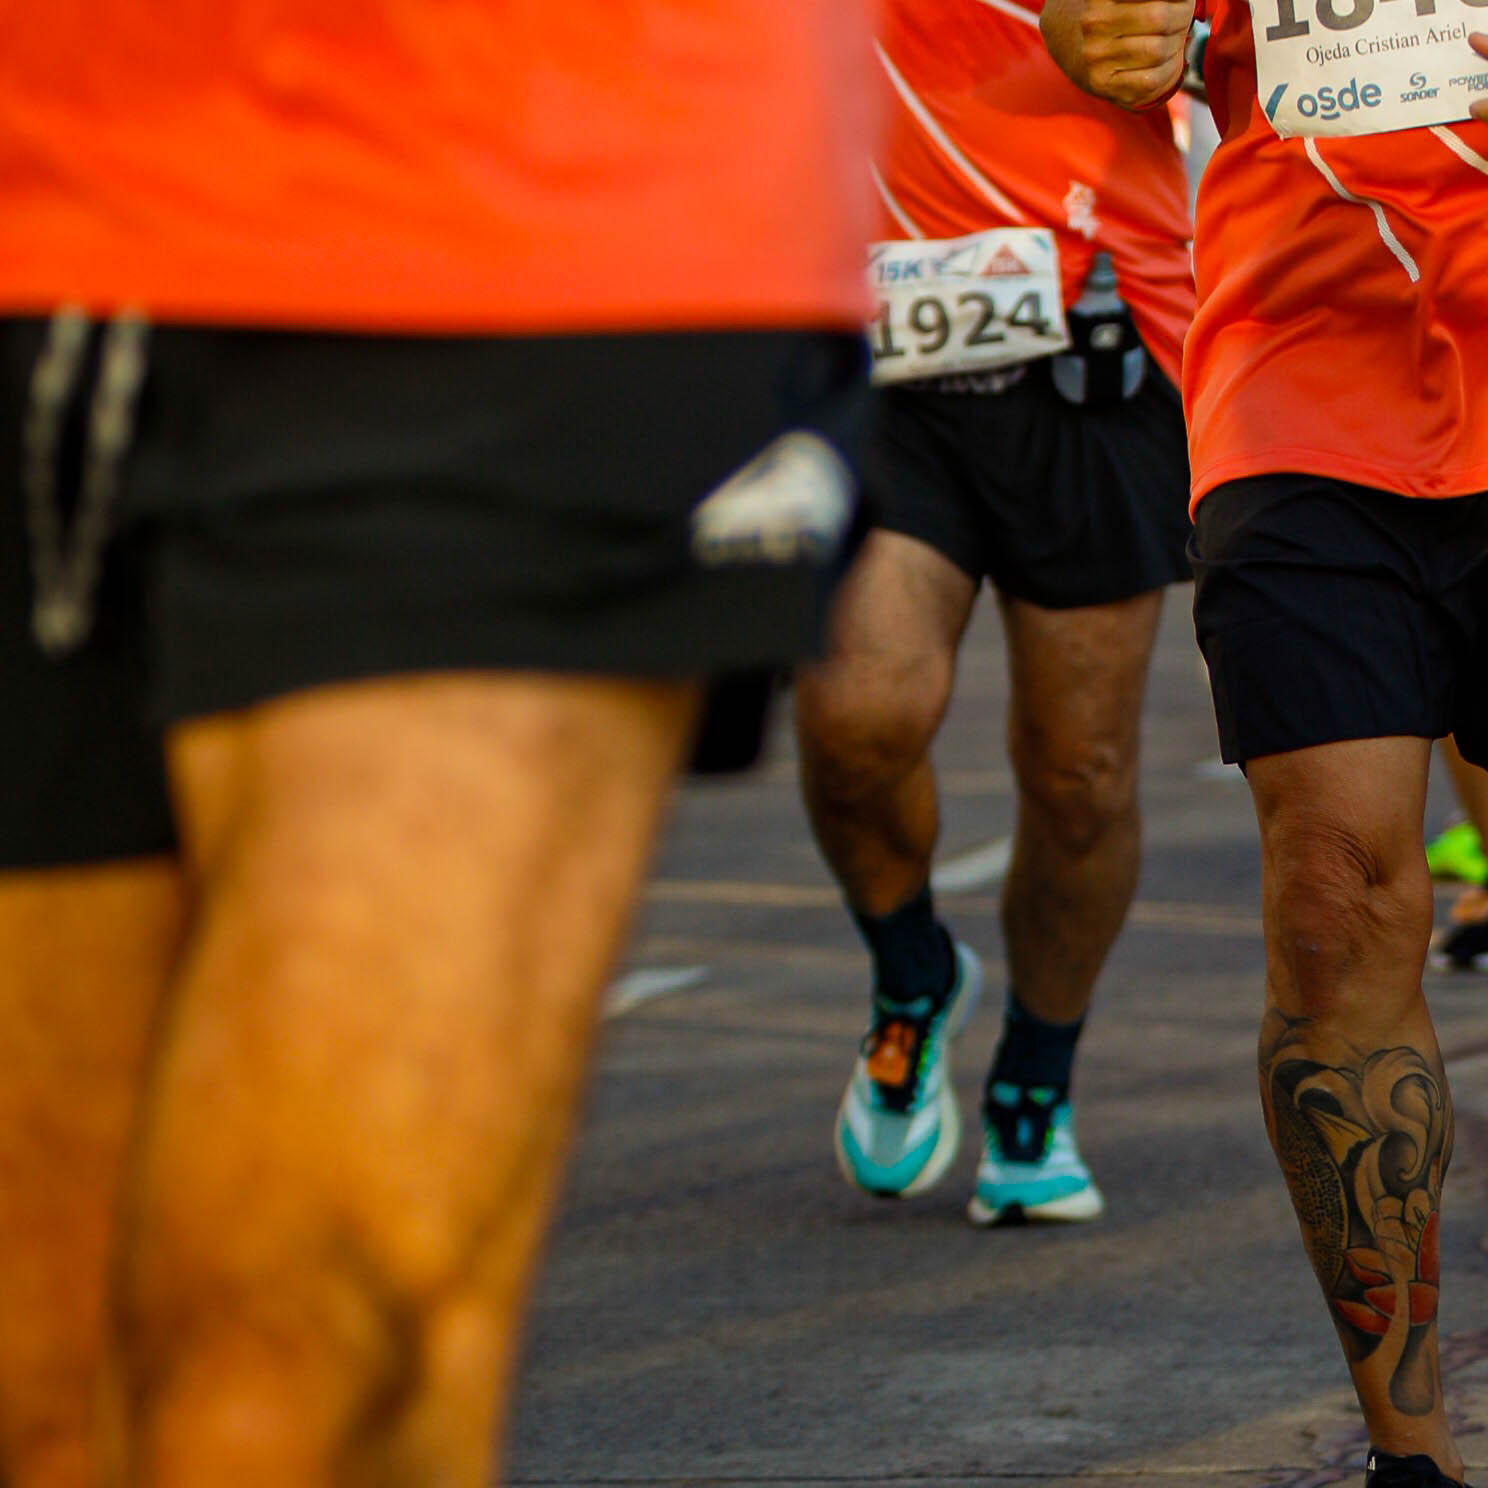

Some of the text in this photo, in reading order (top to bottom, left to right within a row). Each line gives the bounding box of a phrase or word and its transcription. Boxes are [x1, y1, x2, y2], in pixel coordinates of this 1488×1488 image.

[1306, 22, 1467, 66] Ojeda Cristian Ariel
[1297, 77, 1382, 118] osde
[872, 290, 1050, 360] 1924
